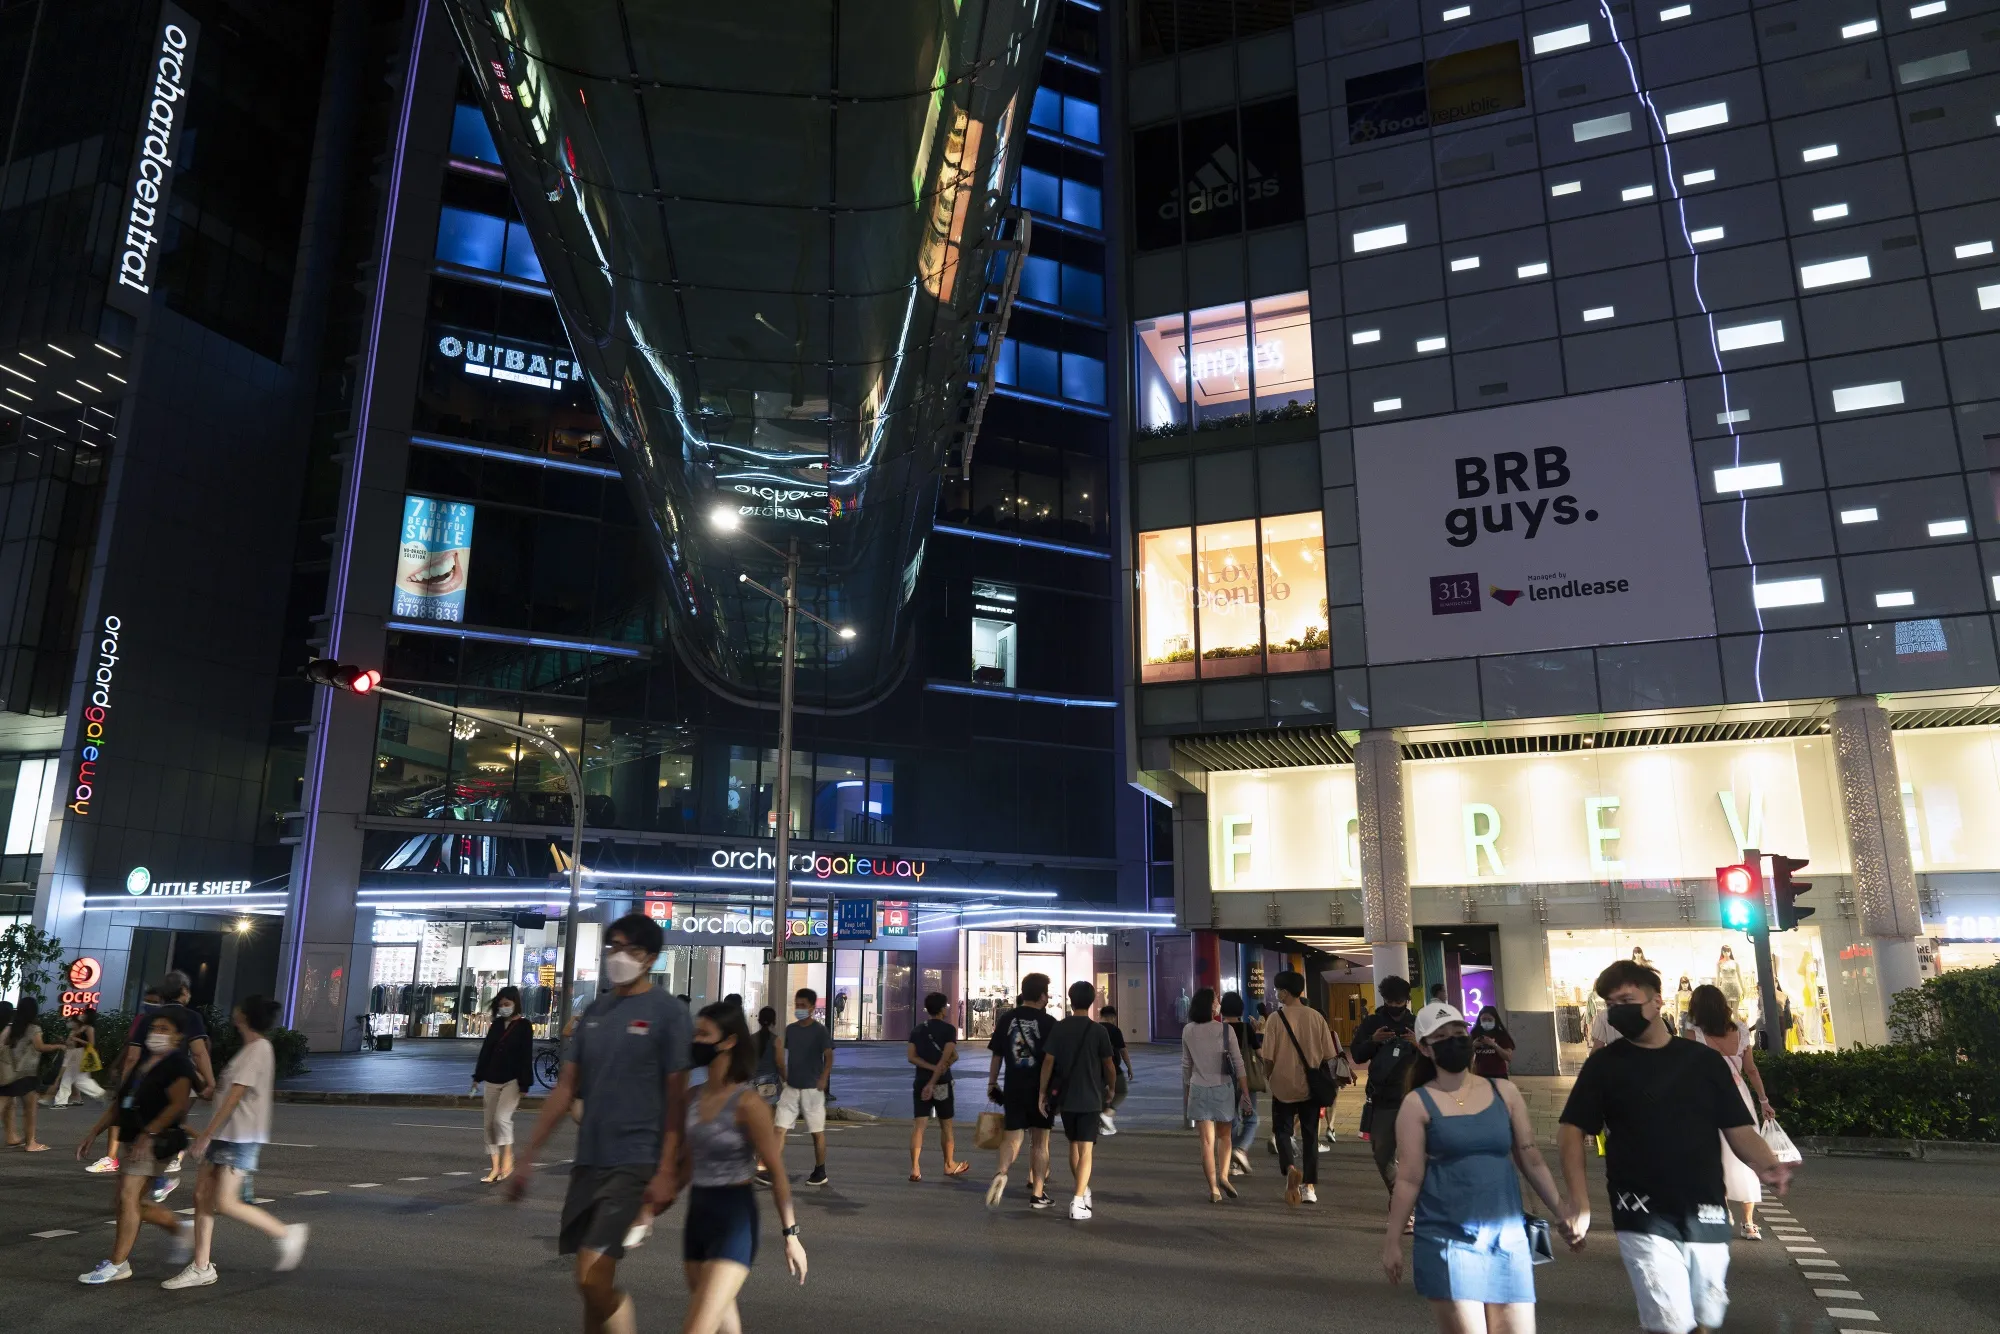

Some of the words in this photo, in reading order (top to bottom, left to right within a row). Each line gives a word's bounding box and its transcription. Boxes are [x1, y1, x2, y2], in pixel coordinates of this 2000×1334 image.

[1378, 109, 1429, 135] food
[1430, 96, 1500, 125] republic
[119, 24, 187, 295] orchardcentral
[1157, 177, 1280, 220] adidas
[439, 336, 585, 382] OUTBACK
[1455, 445, 1571, 499] BRB
[411, 498, 425, 517] 7
[429, 502, 467, 517] DAYS
[408, 516, 466, 532] BEAUTIFUL
[1444, 493, 1600, 547] guys.
[406, 524, 464, 546] SMILE
[1527, 573, 1557, 581] Managed
[1559, 572, 1567, 580] by
[1438, 580, 1473, 600] 313
[1528, 578, 1630, 602] lendlease
[396, 602, 458, 623] 67385833
[68, 615, 121, 815] orchardgateway
[711, 847, 925, 883] orchrdgateway
[151, 882, 198, 896] LITTLE
[202, 881, 252, 895] SHEEP
[653, 919, 668, 928] RT
[852, 928, 871, 936] Crossing
[888, 926, 905, 934] MRT
[766, 950, 805, 961] OARD
[808, 950, 819, 961] RD
[62, 991, 101, 1004] OCBC
[62, 1003, 97, 1017] Ba
